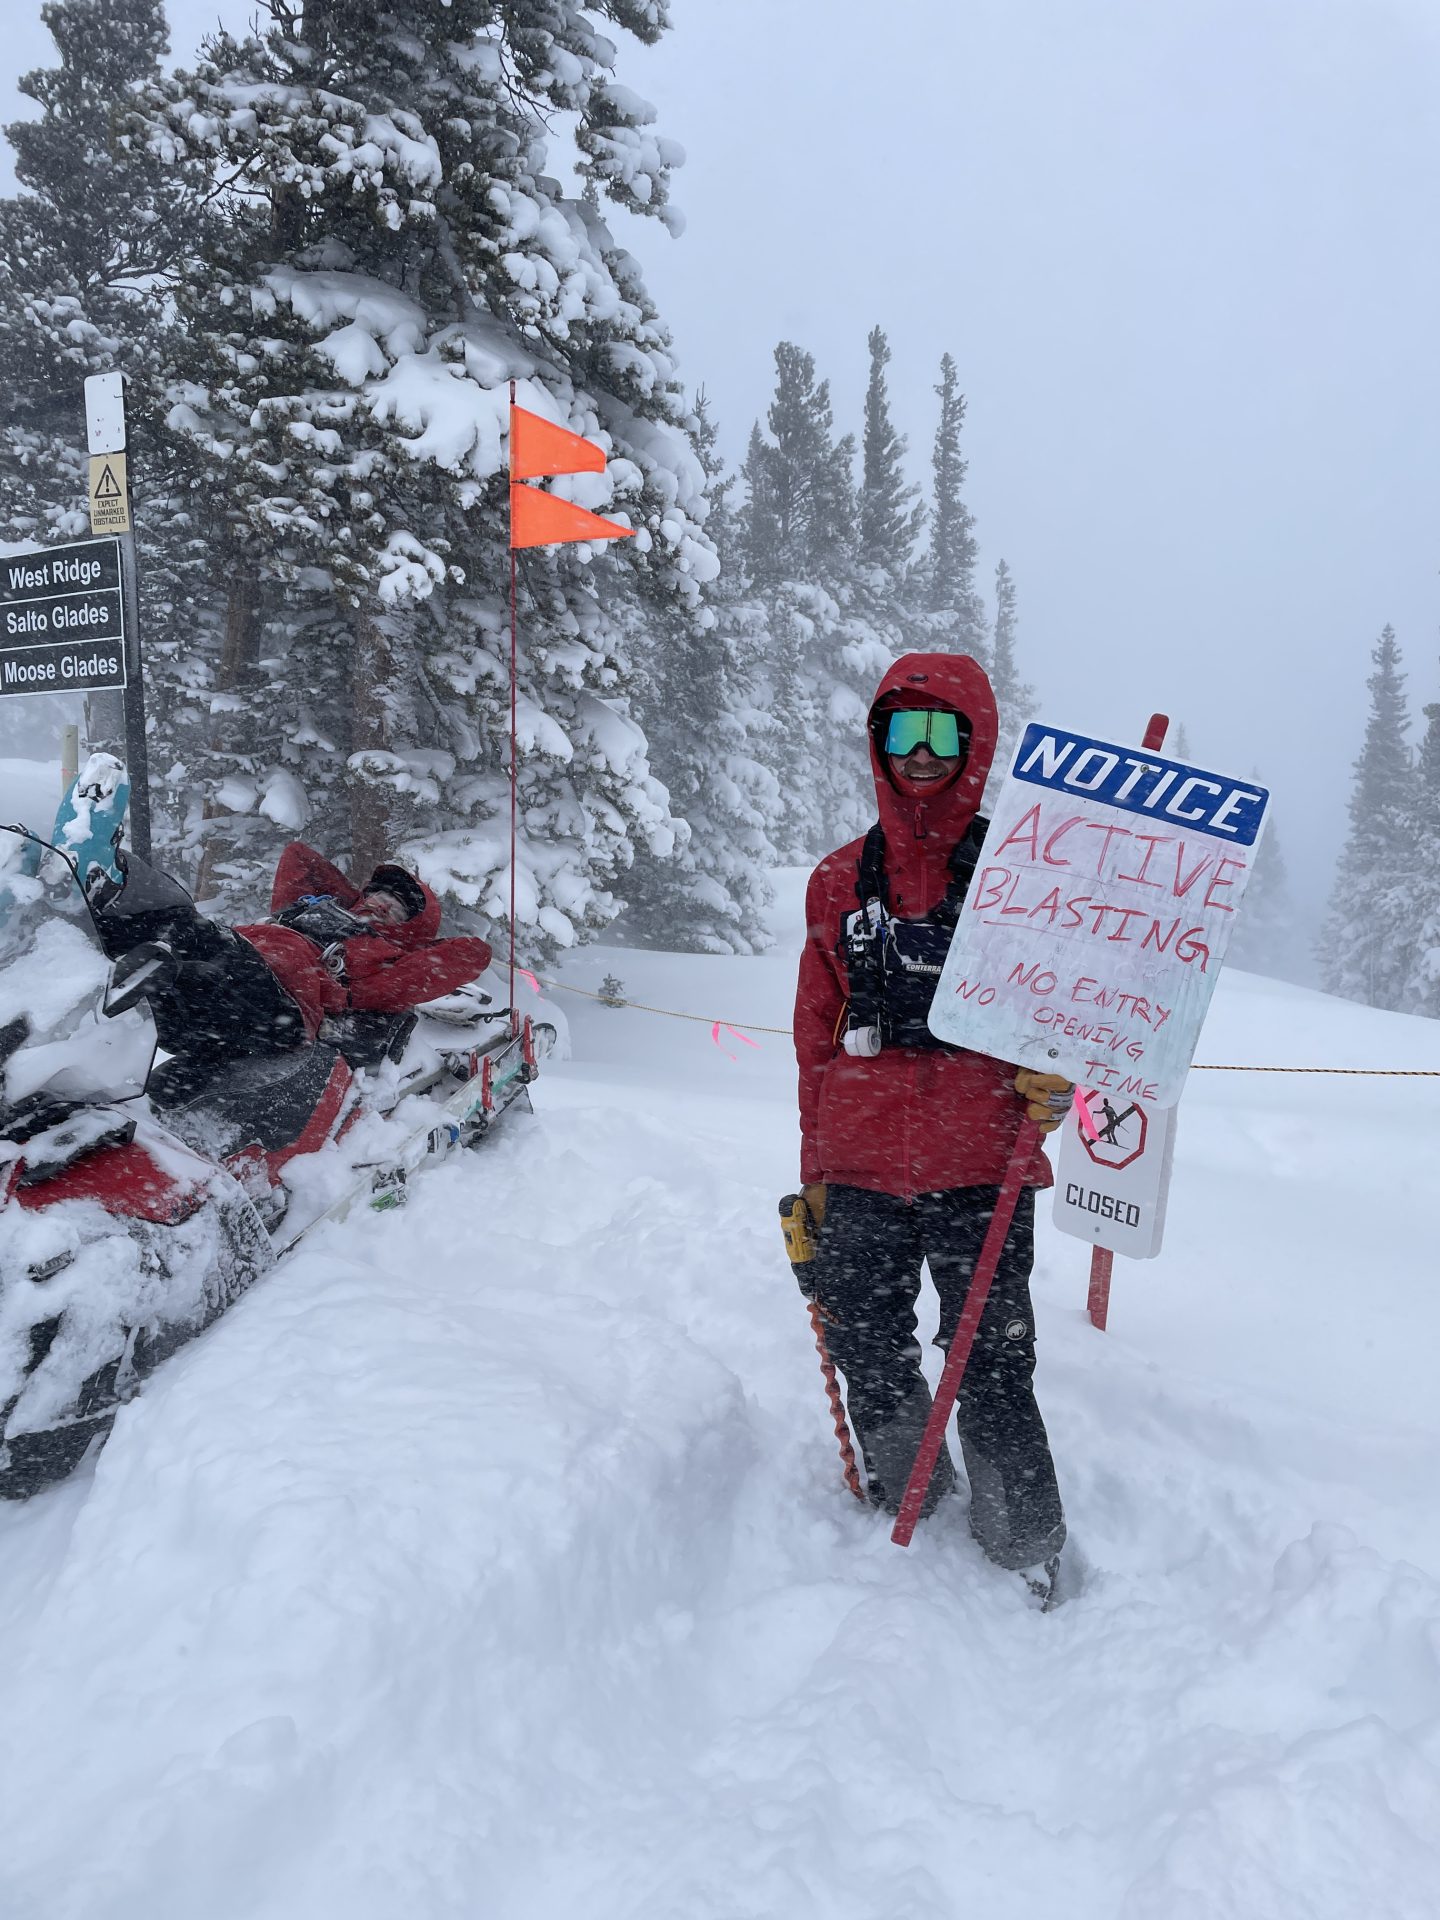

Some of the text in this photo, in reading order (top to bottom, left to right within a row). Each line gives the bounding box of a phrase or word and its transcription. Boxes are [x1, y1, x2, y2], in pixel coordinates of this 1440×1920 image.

[93, 508, 125, 517] UNMARKED
[93, 516, 126, 526] OBSTACLES
[97, 499, 119, 508] EXPECT
[8, 558, 101, 590] West Ridge
[6, 603, 109, 635] Salto Glades
[4, 653, 118, 684] Moose Glades
[1019, 735, 1262, 833] NOTICE
[994, 802, 1247, 912] ACTIVE
[972, 866, 1209, 973] BLASTING
[905, 963, 943, 972] CONTERRA
[1007, 962, 1172, 1032] NO ENTRY
[955, 980, 1145, 1063] NO OPENING
[1085, 1060, 1159, 1101] TIME
[1065, 1183, 1141, 1228] CLOSED
